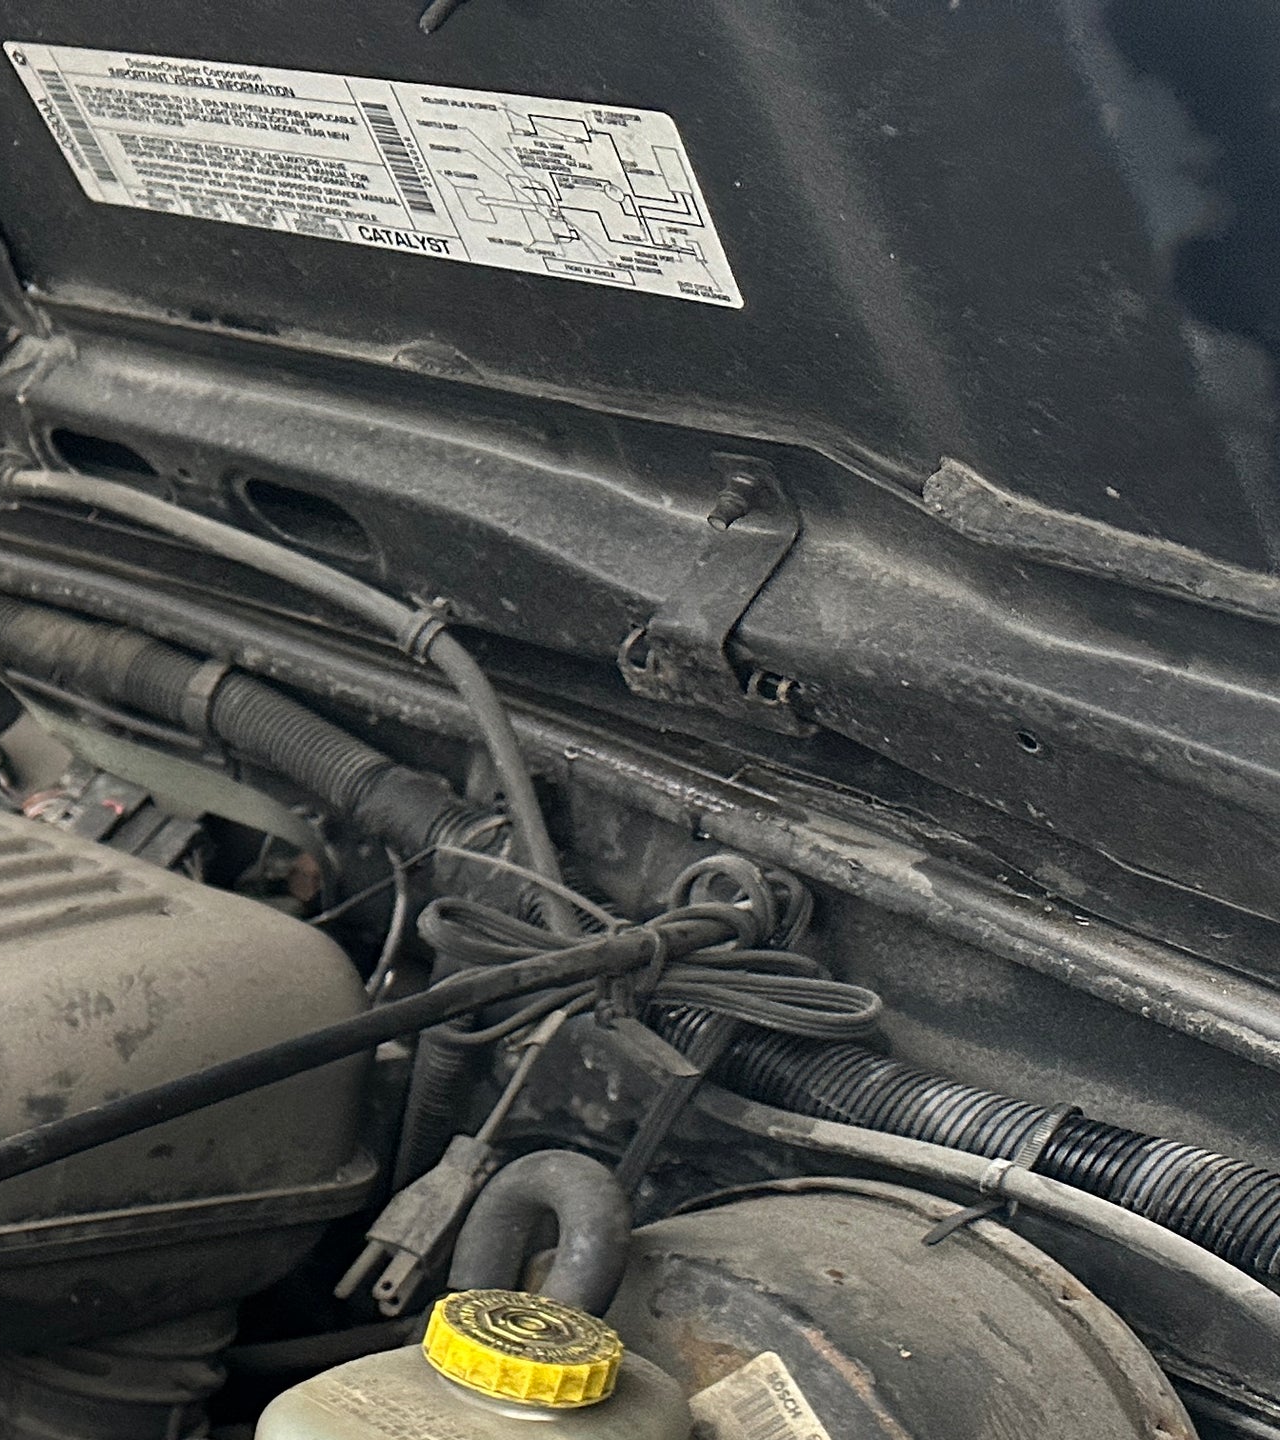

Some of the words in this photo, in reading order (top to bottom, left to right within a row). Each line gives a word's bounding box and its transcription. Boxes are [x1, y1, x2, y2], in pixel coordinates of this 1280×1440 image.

[215, 79, 296, 98] INFORMATION
[356, 225, 453, 254] CATALYST
[769, 1371, 802, 1419] BOSCH
